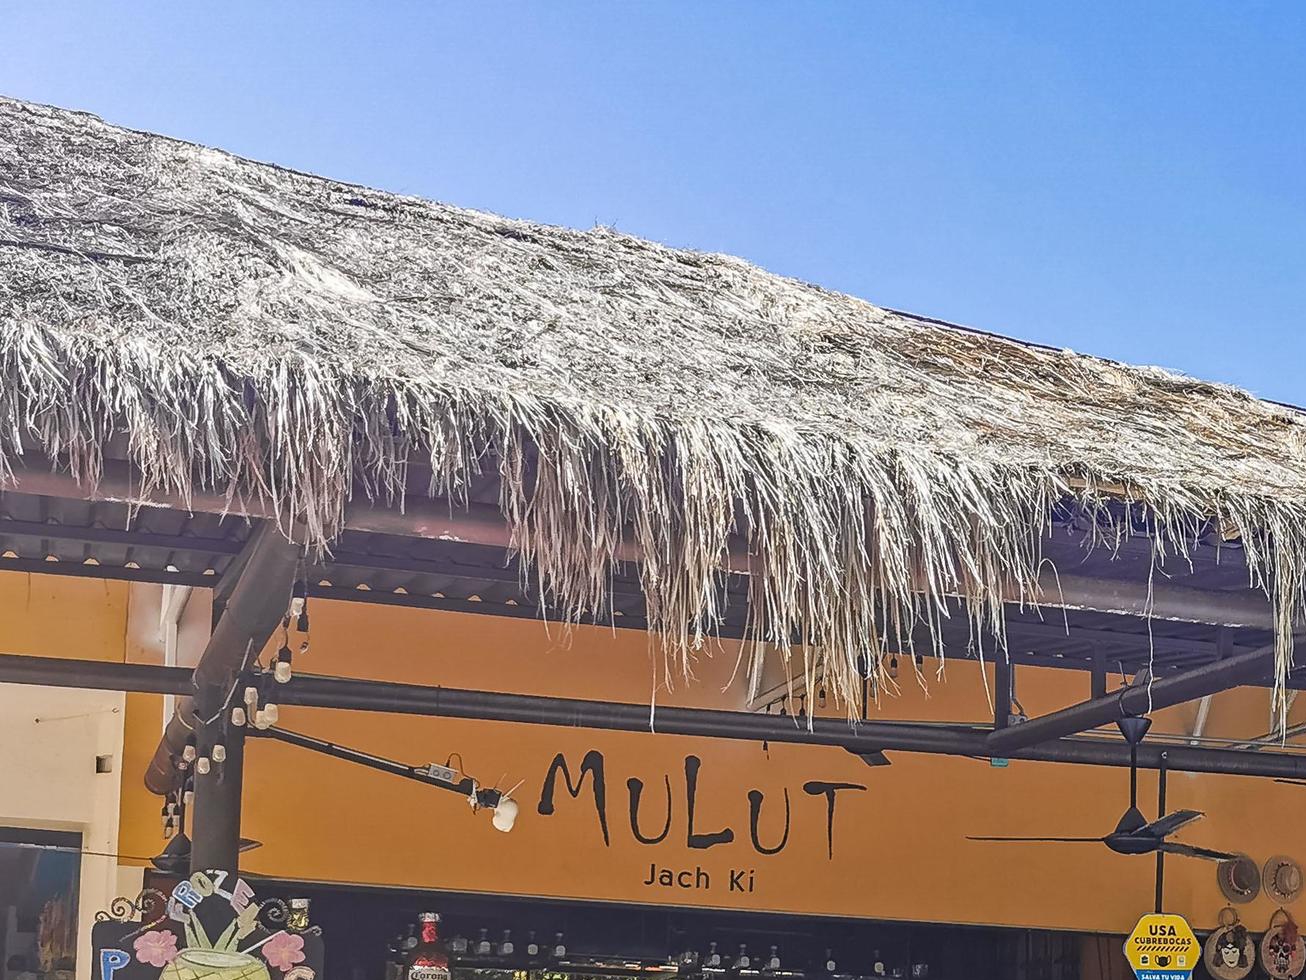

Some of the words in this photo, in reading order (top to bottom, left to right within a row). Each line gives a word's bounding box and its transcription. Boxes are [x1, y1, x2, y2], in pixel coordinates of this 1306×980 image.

[537, 750, 867, 860] MULUT
[644, 863, 709, 889] Jach
[1149, 925, 1177, 936] USA
[1134, 937, 1192, 945] CUBREBOCAS
[411, 971, 448, 980] Corona
